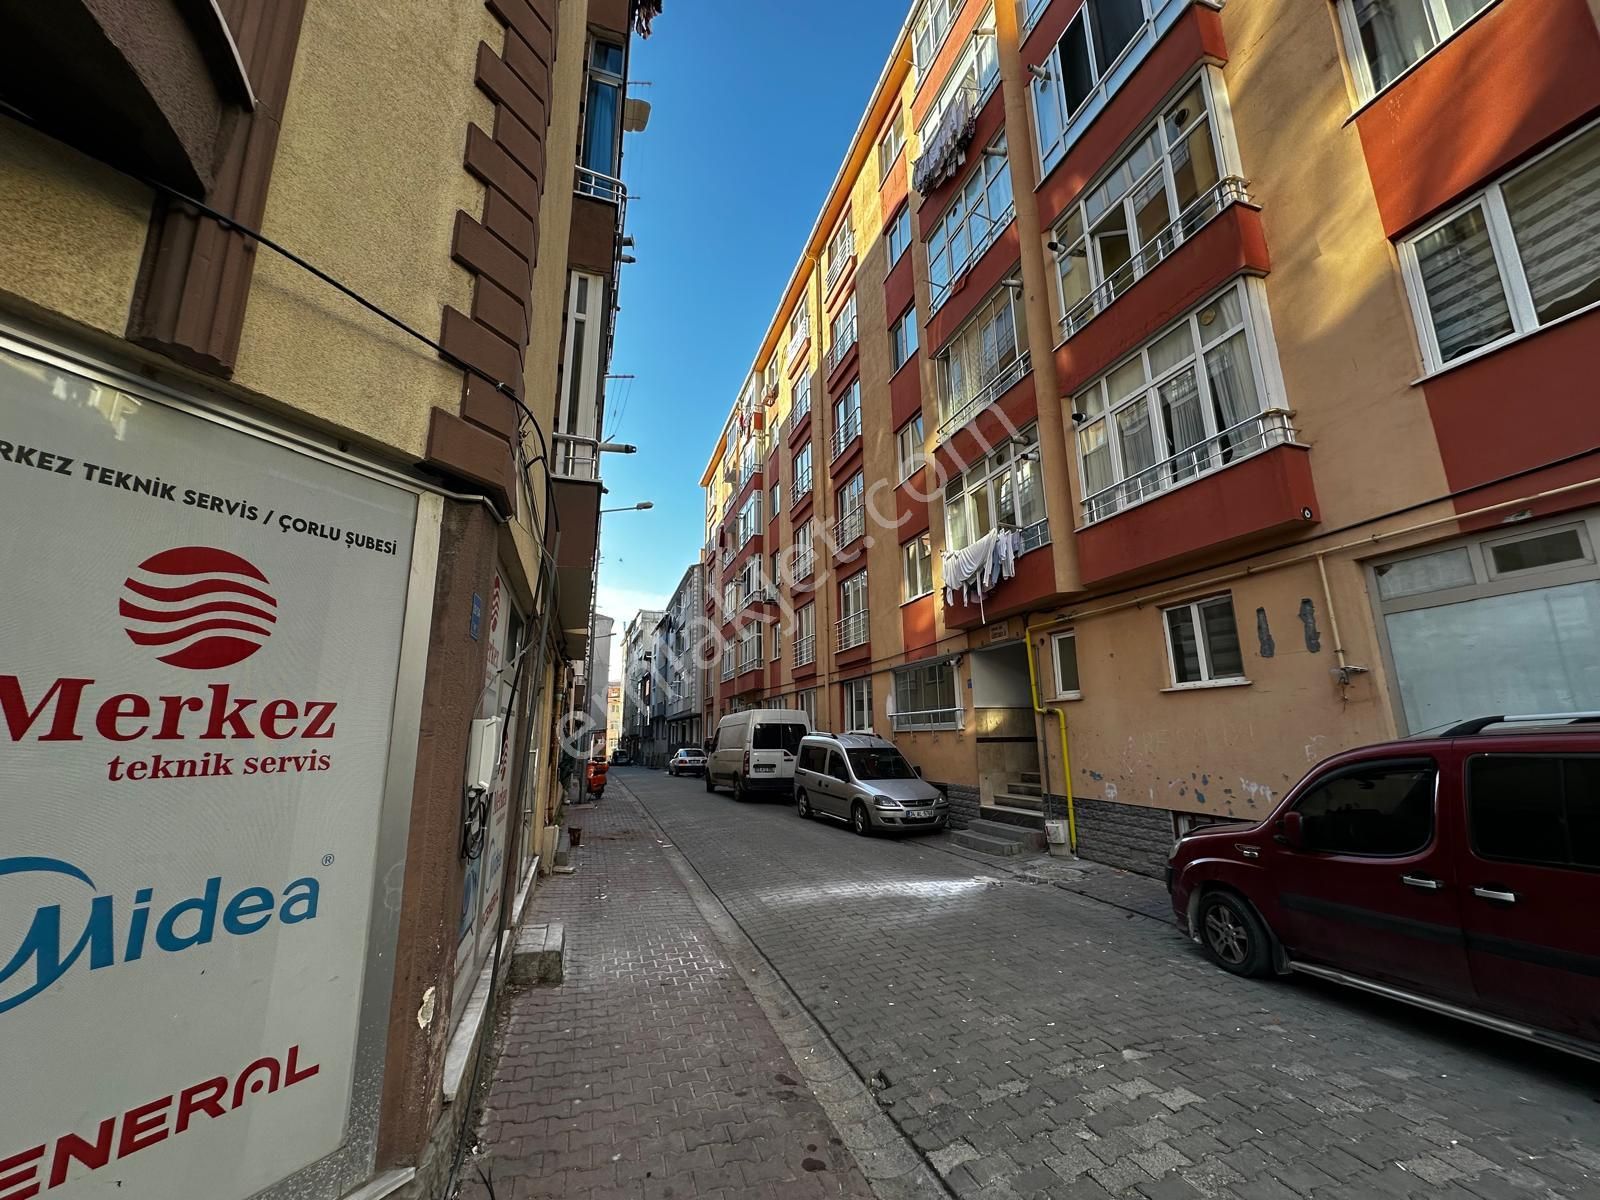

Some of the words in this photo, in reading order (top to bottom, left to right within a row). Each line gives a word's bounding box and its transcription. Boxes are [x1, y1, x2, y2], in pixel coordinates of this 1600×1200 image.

[82, 462, 177, 501] TEKNİK
[182, 489, 259, 521] SERVİS
[263, 510, 275, 525] /
[278, 515, 341, 542] ÇORLU
[345, 531, 398, 556] ŞUBESİ
[0, 674, 338, 742] Merkez
[107, 752, 234, 782] teknik
[242, 748, 331, 775] servis
[0, 856, 321, 1014] Midea
